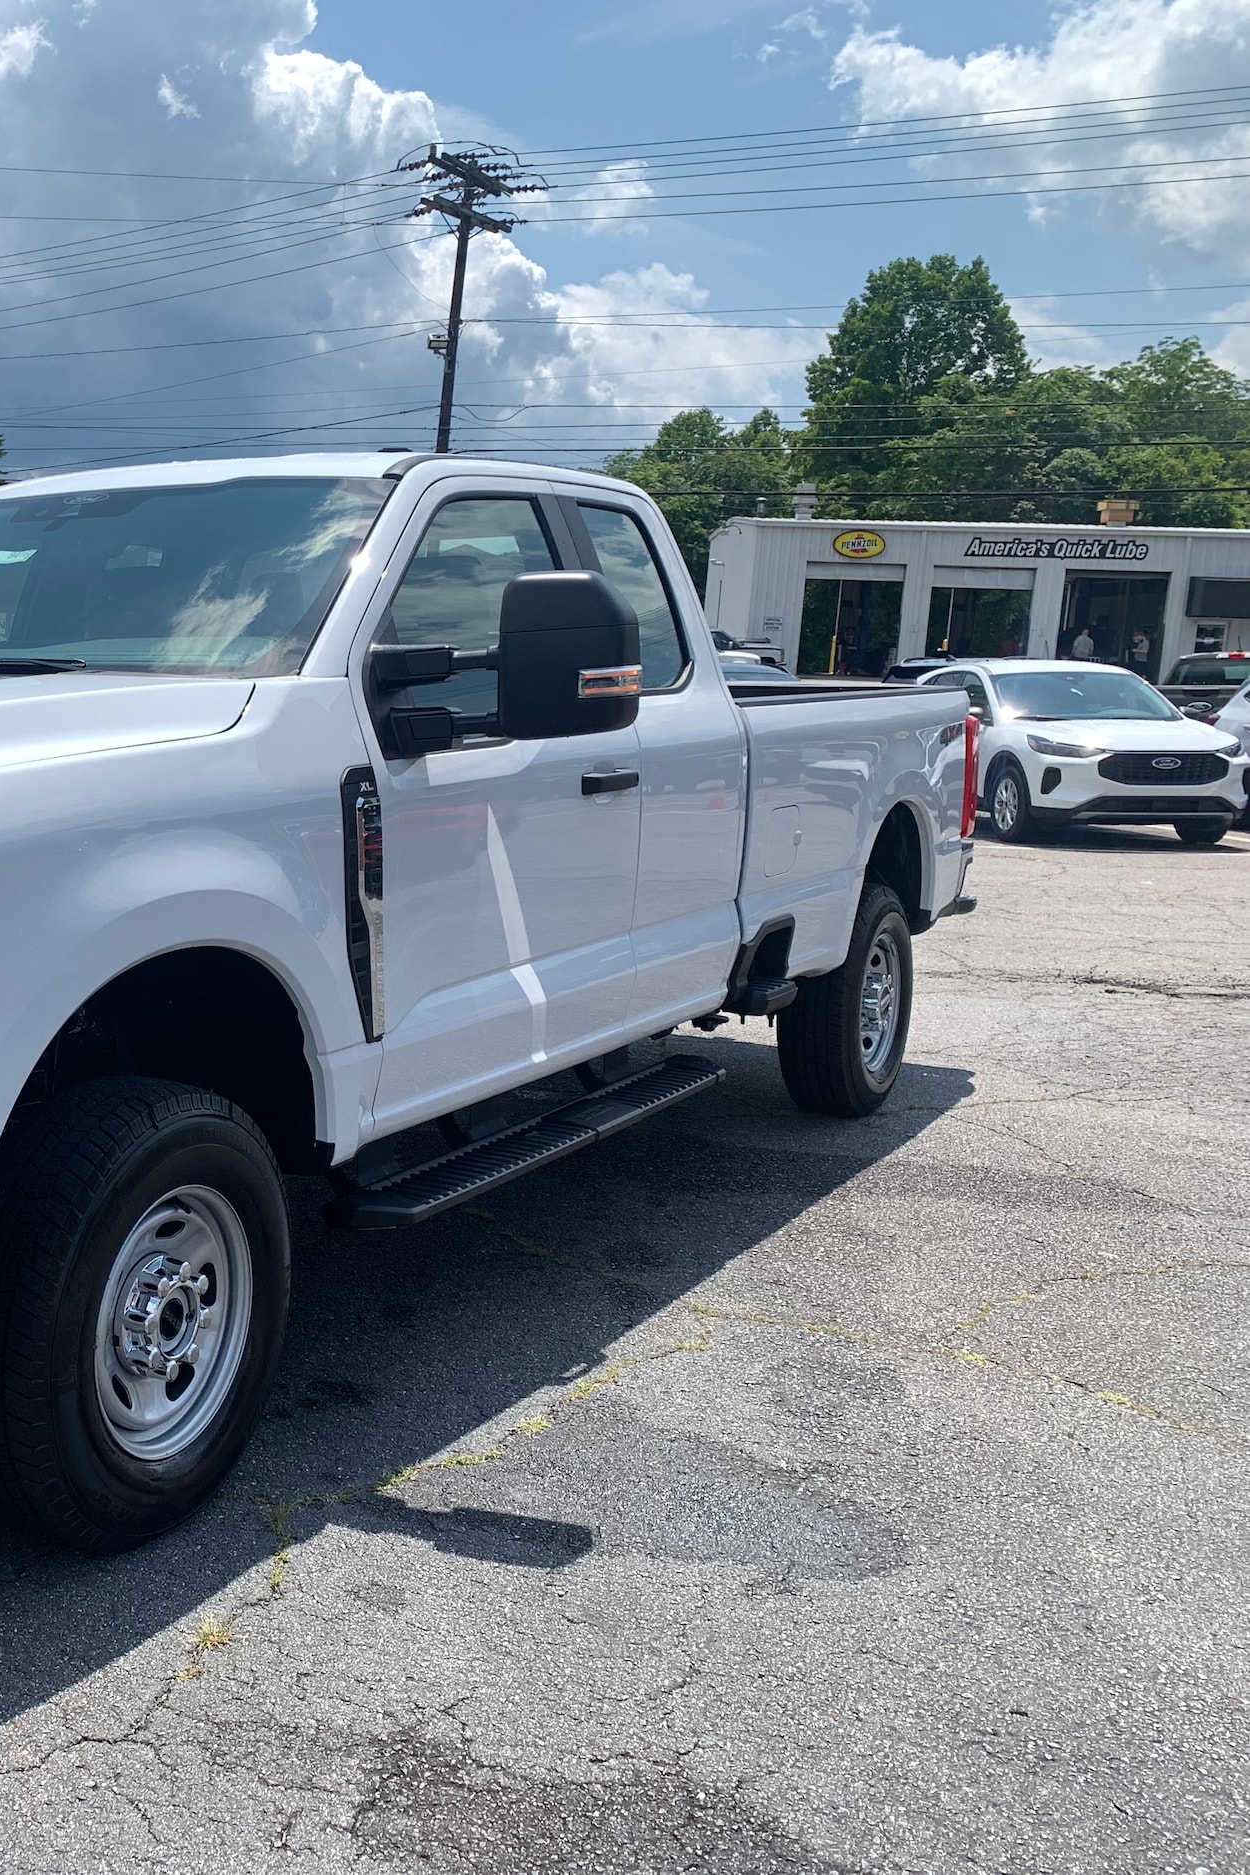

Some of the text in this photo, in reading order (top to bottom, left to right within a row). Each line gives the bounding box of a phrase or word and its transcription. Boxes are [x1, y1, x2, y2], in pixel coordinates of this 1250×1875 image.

[841, 539, 878, 550] PENNZOIL
[965, 537, 1149, 560] America's Quick Lube
[359, 781, 375, 792] XL
